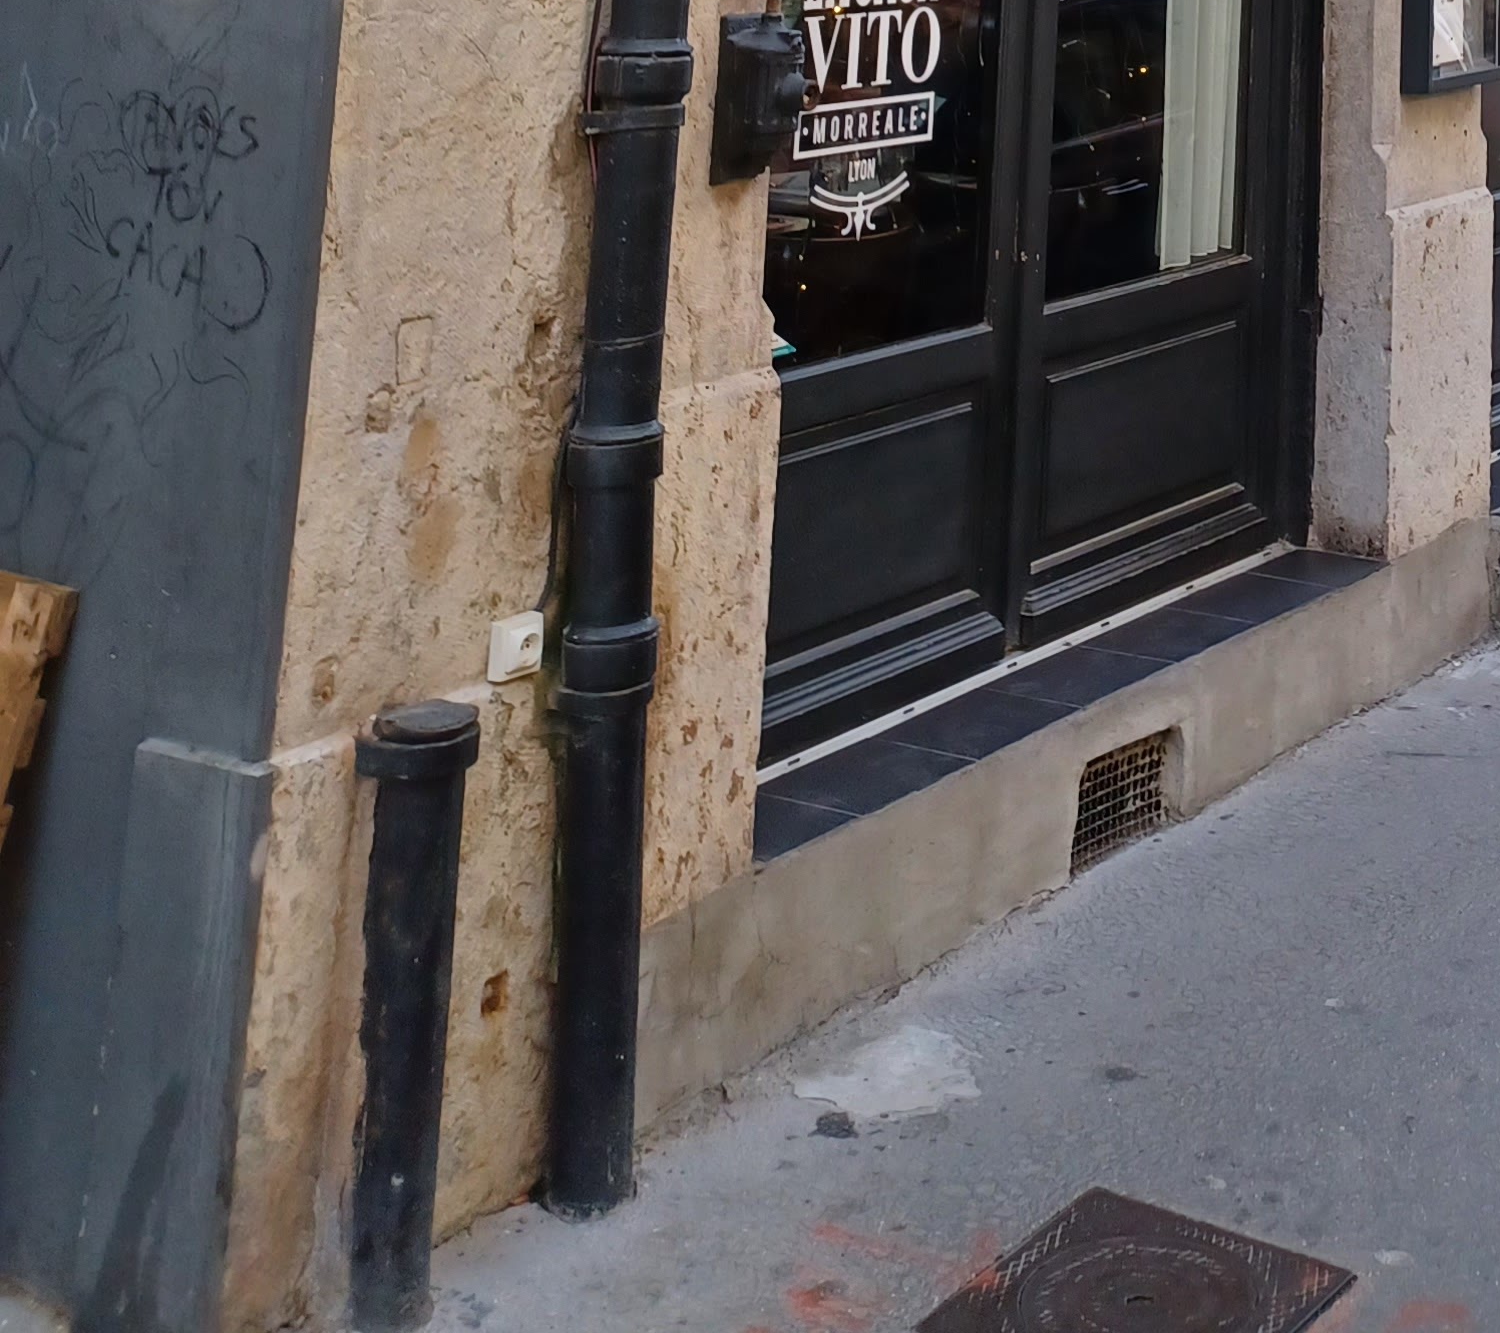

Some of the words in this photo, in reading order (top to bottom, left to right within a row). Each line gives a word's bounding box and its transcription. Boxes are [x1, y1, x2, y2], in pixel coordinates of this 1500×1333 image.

[804, 6, 941, 94] VITO
[812, 105, 919, 145] MORREALE
[848, 157, 876, 183] LYON
